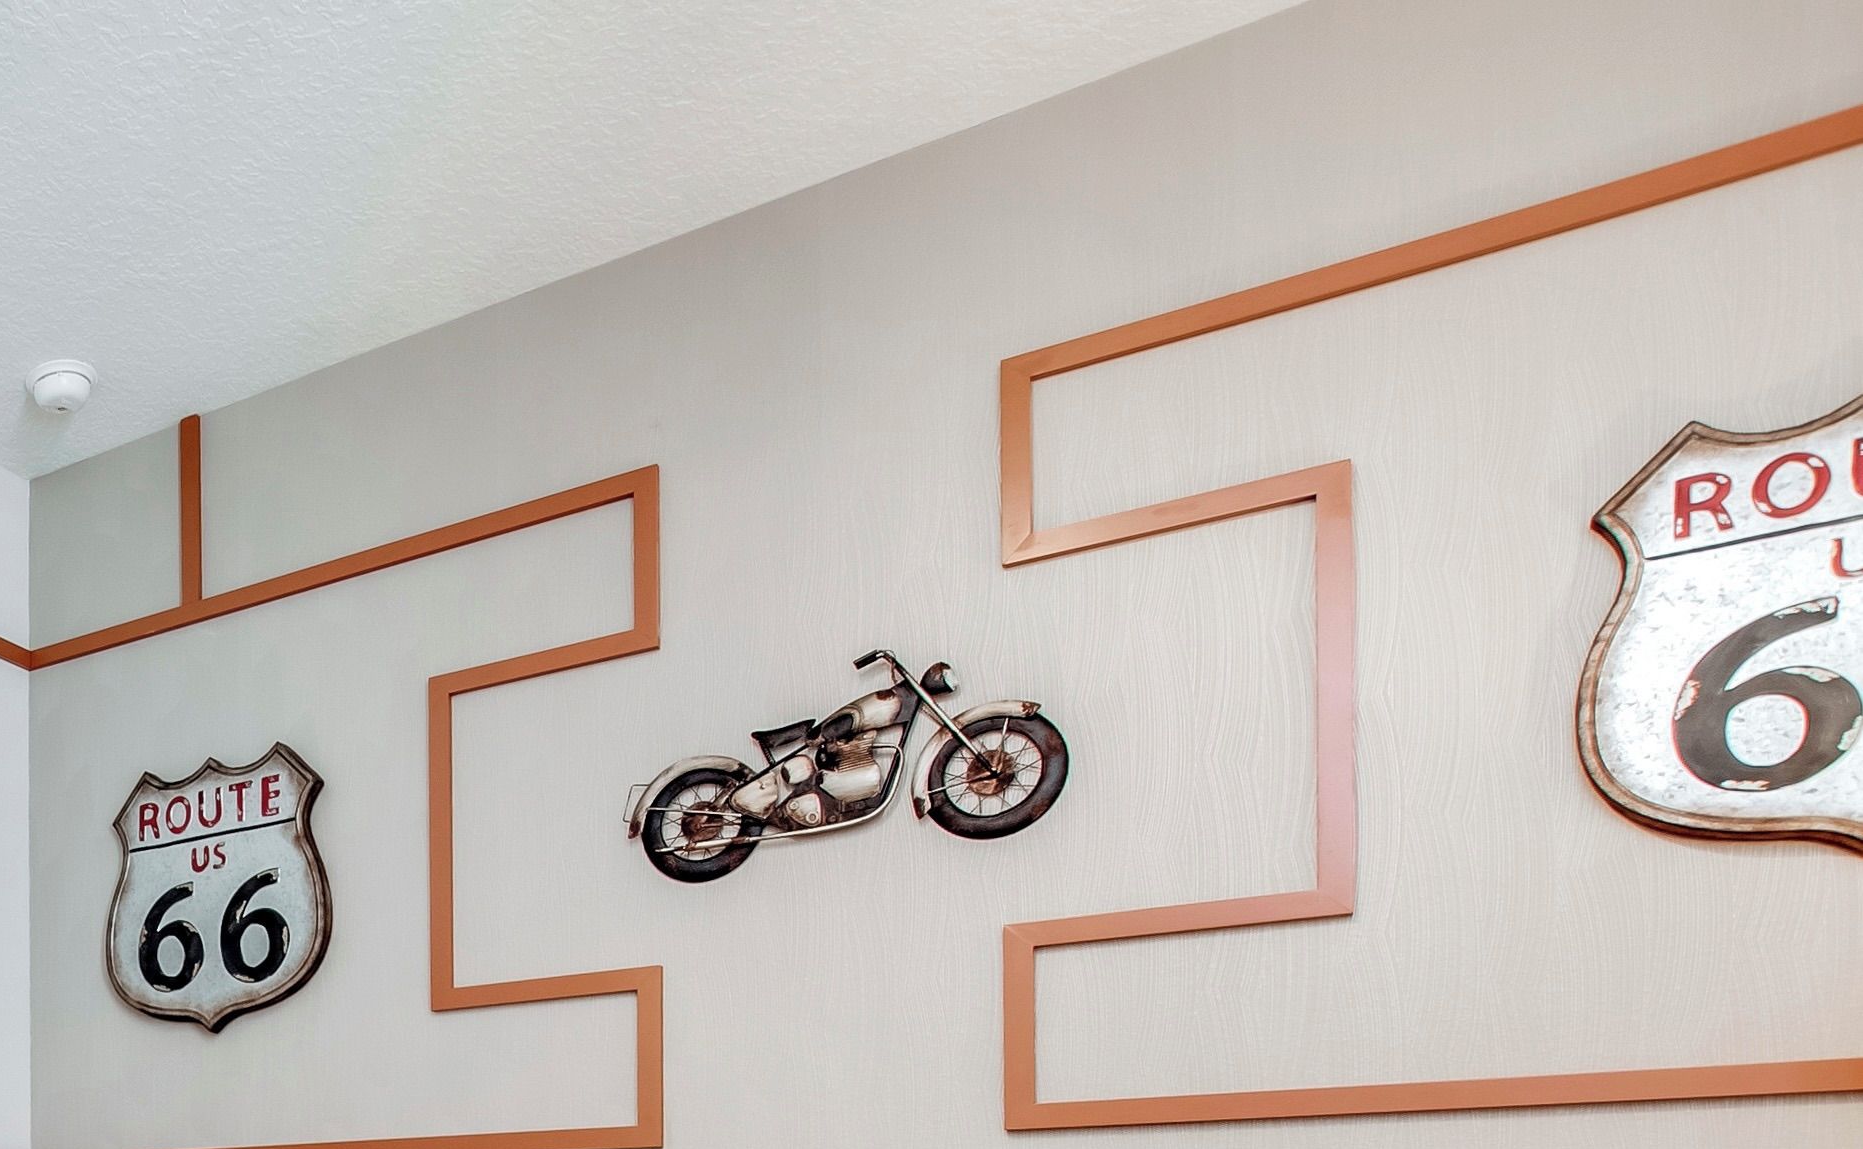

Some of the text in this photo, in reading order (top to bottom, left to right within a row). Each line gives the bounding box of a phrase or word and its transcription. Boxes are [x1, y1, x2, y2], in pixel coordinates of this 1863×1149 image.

[1673, 437, 1863, 541] RO
[138, 773, 281, 842] ROUTE
[190, 841, 227, 873] US
[138, 866, 291, 993] 66
